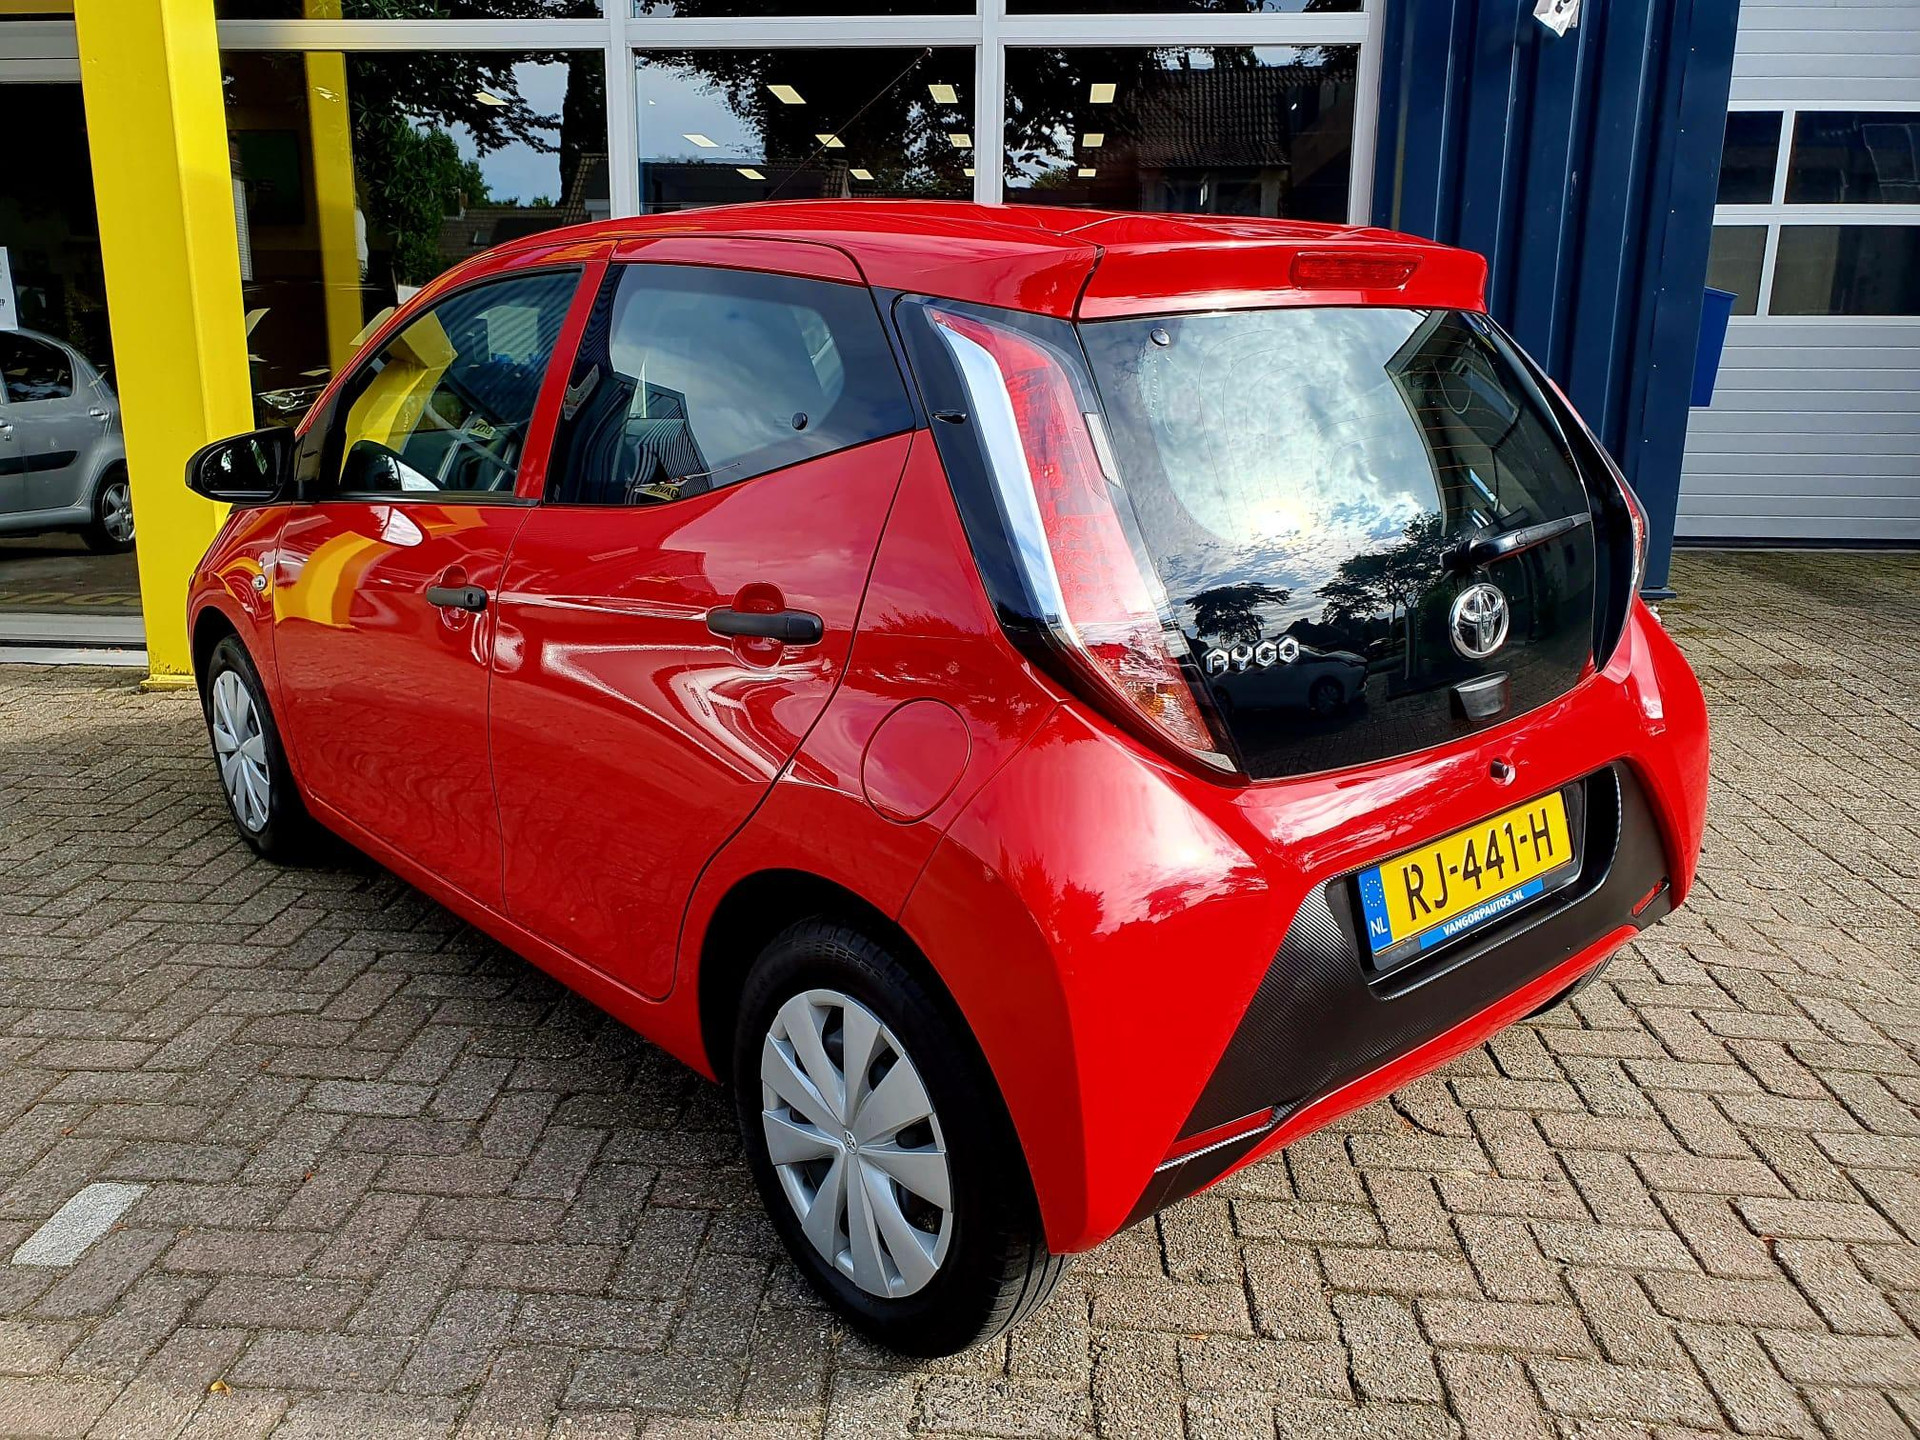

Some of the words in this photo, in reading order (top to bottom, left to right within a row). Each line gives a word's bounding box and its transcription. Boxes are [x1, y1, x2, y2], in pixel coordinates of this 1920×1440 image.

[1205, 636, 1300, 675] AYGO
[1402, 808, 1554, 921] RJ-441-H
[1370, 916, 1389, 938] NL
[1442, 891, 1525, 936] VANGORPAUTOS.NL
